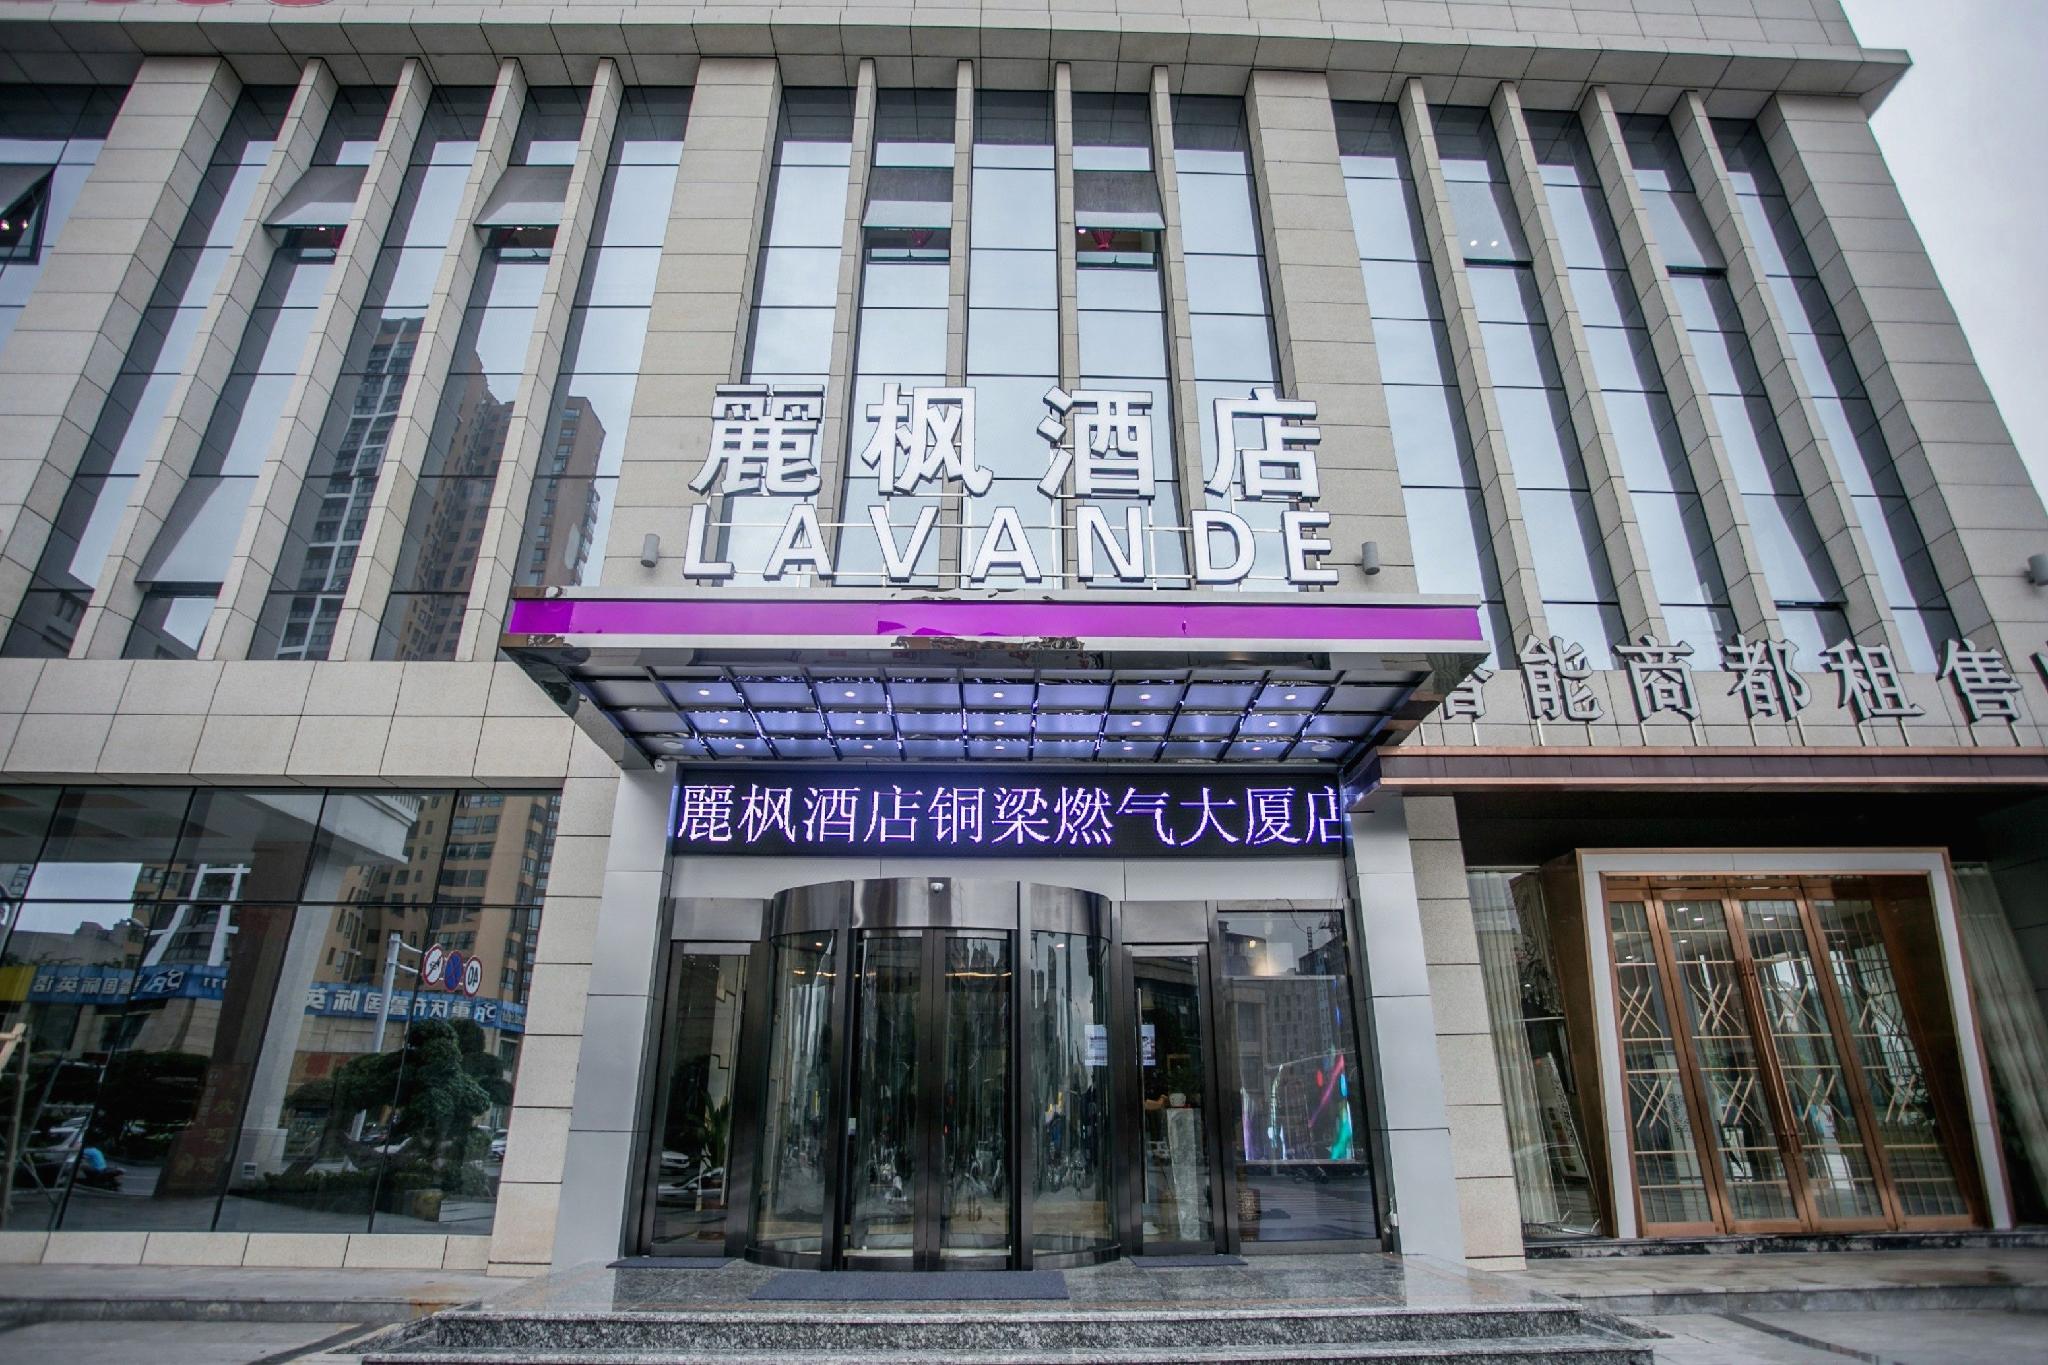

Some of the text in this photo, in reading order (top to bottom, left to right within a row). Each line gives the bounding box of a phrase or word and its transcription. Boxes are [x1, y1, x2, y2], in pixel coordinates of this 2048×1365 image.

[688, 383, 1322, 500] 麗枫酒店
[684, 503, 1340, 586] LAVANDE
[1441, 633, 2048, 721] 能商都租售
[677, 783, 1342, 845] 麗枫酒店铜梁燃气大厦店
